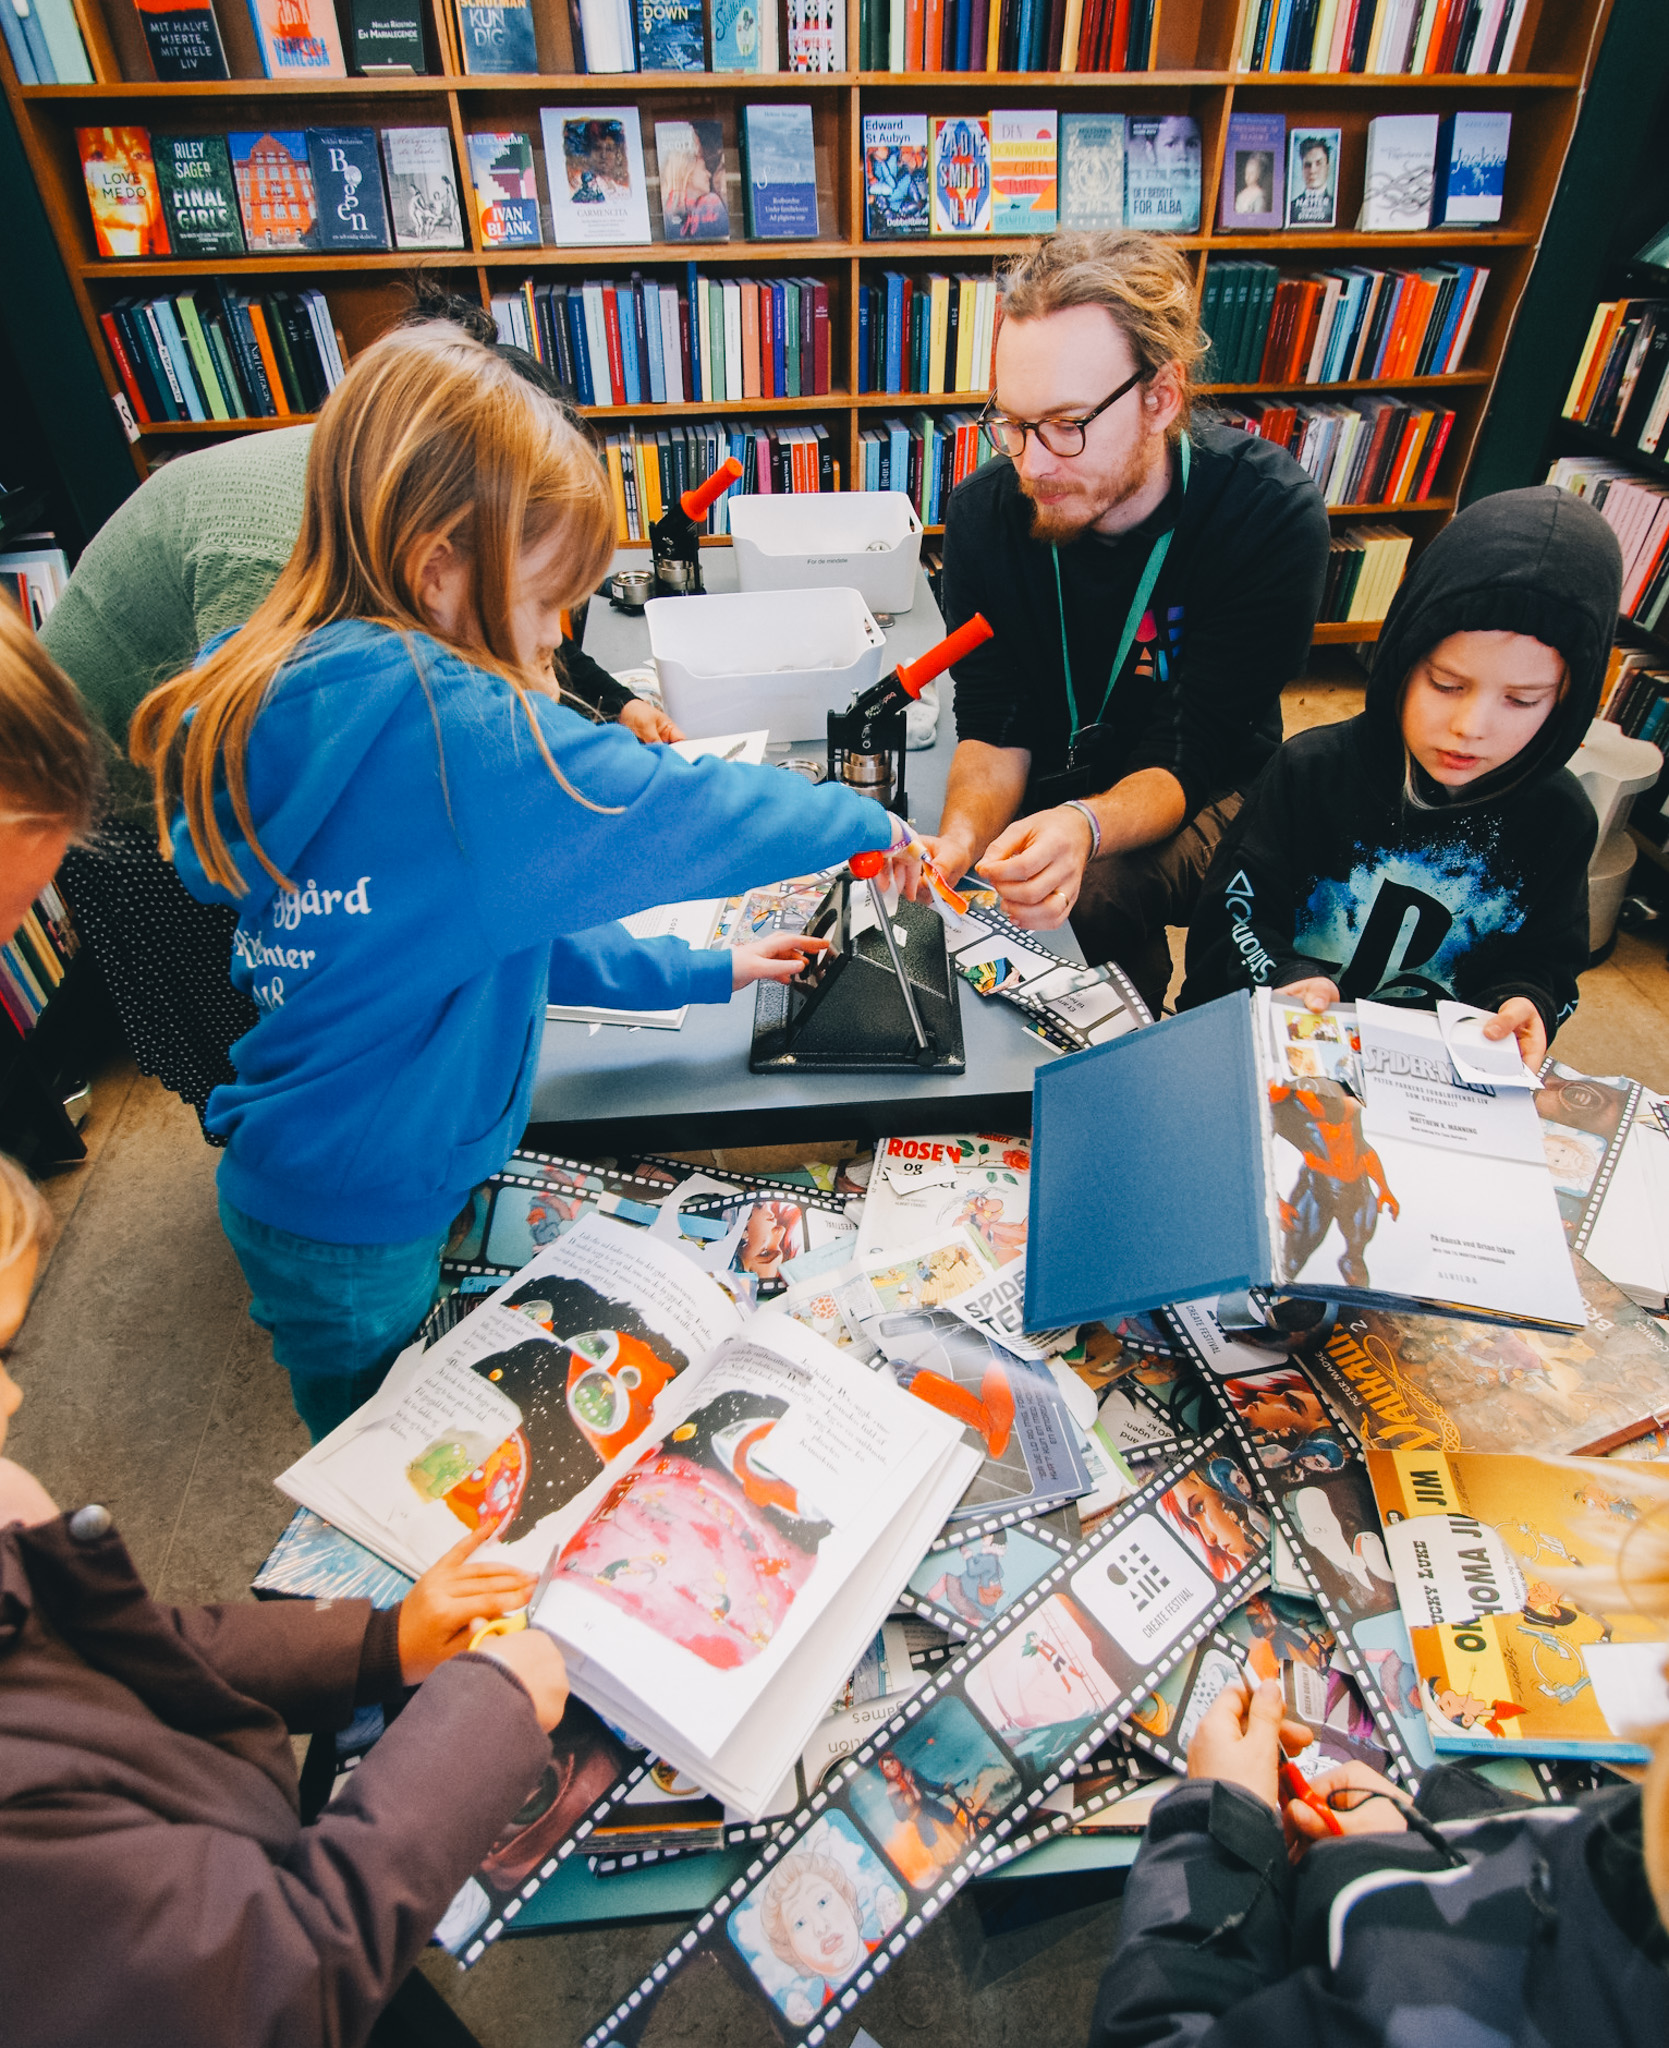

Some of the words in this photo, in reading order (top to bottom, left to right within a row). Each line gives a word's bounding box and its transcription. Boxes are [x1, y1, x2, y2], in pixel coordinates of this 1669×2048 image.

[470, 9, 505, 28] KUN
[644, 5, 688, 20] DOWN
[150, 22, 171, 33] MIT
[175, 21, 210, 33] HALVE
[474, 28, 504, 47] DIG
[161, 46, 181, 57] MIT
[184, 46, 213, 57] HELE
[180, 58, 198, 70] LIV
[865, 119, 903, 131] Edward
[866, 133, 877, 143] St
[879, 132, 911, 145] Aubyn
[940, 131, 987, 159] ZADIE
[174, 142, 204, 159] RILEY
[103, 172, 142, 185] LOVE
[175, 161, 212, 179] SAGER
[939, 162, 986, 189] SMITH
[103, 187, 121, 199] ME
[123, 186, 147, 198] DO
[173, 187, 227, 208] FINAL
[493, 207, 523, 222] IVAN
[1134, 199, 1154, 215] FOR
[1157, 199, 1182, 215] ALBA
[177, 209, 228, 229] GIRLS
[487, 221, 533, 236] BLANK
[1364, 1045, 1496, 1098] SPIDER-M
[887, 1137, 963, 1165] ROSEN
[903, 1162, 924, 1176] og
[1185, 1304, 1201, 1328] CREATE
[1199, 1326, 1221, 1355] FESTIVAL
[1350, 1319, 1368, 1333] 2
[1633, 1320, 1669, 1353] COMICS
[1314, 1350, 1342, 1381] MADSE
[1337, 1380, 1362, 1407] PETER
[1409, 1469, 1448, 1507] JIM
[1412, 1539, 1435, 1581] LUKE
[1142, 1610, 1170, 1640] CREATE
[1165, 1587, 1195, 1618] FESTIVAL
[1423, 1584, 1446, 1627] UCKY
[852, 1700, 905, 1724] games
